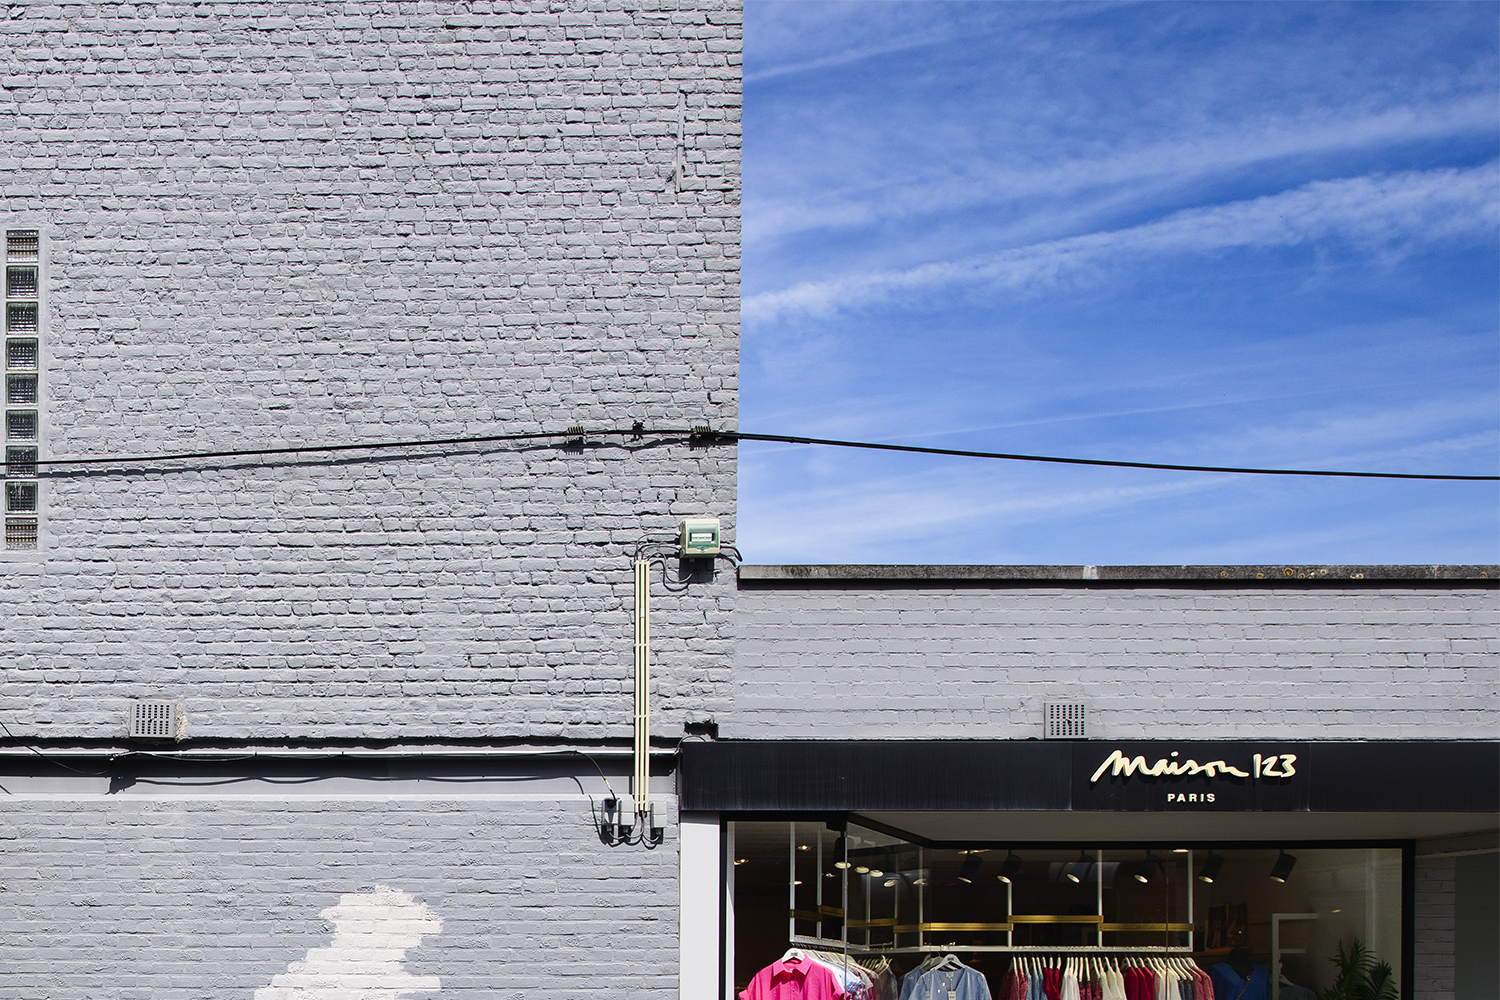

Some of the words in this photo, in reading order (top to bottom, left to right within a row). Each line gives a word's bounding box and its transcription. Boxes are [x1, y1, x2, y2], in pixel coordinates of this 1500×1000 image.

[1090, 749, 1250, 782] Maison
[1252, 753, 1298, 779] 123
[1166, 793, 1216, 803] PARIS
